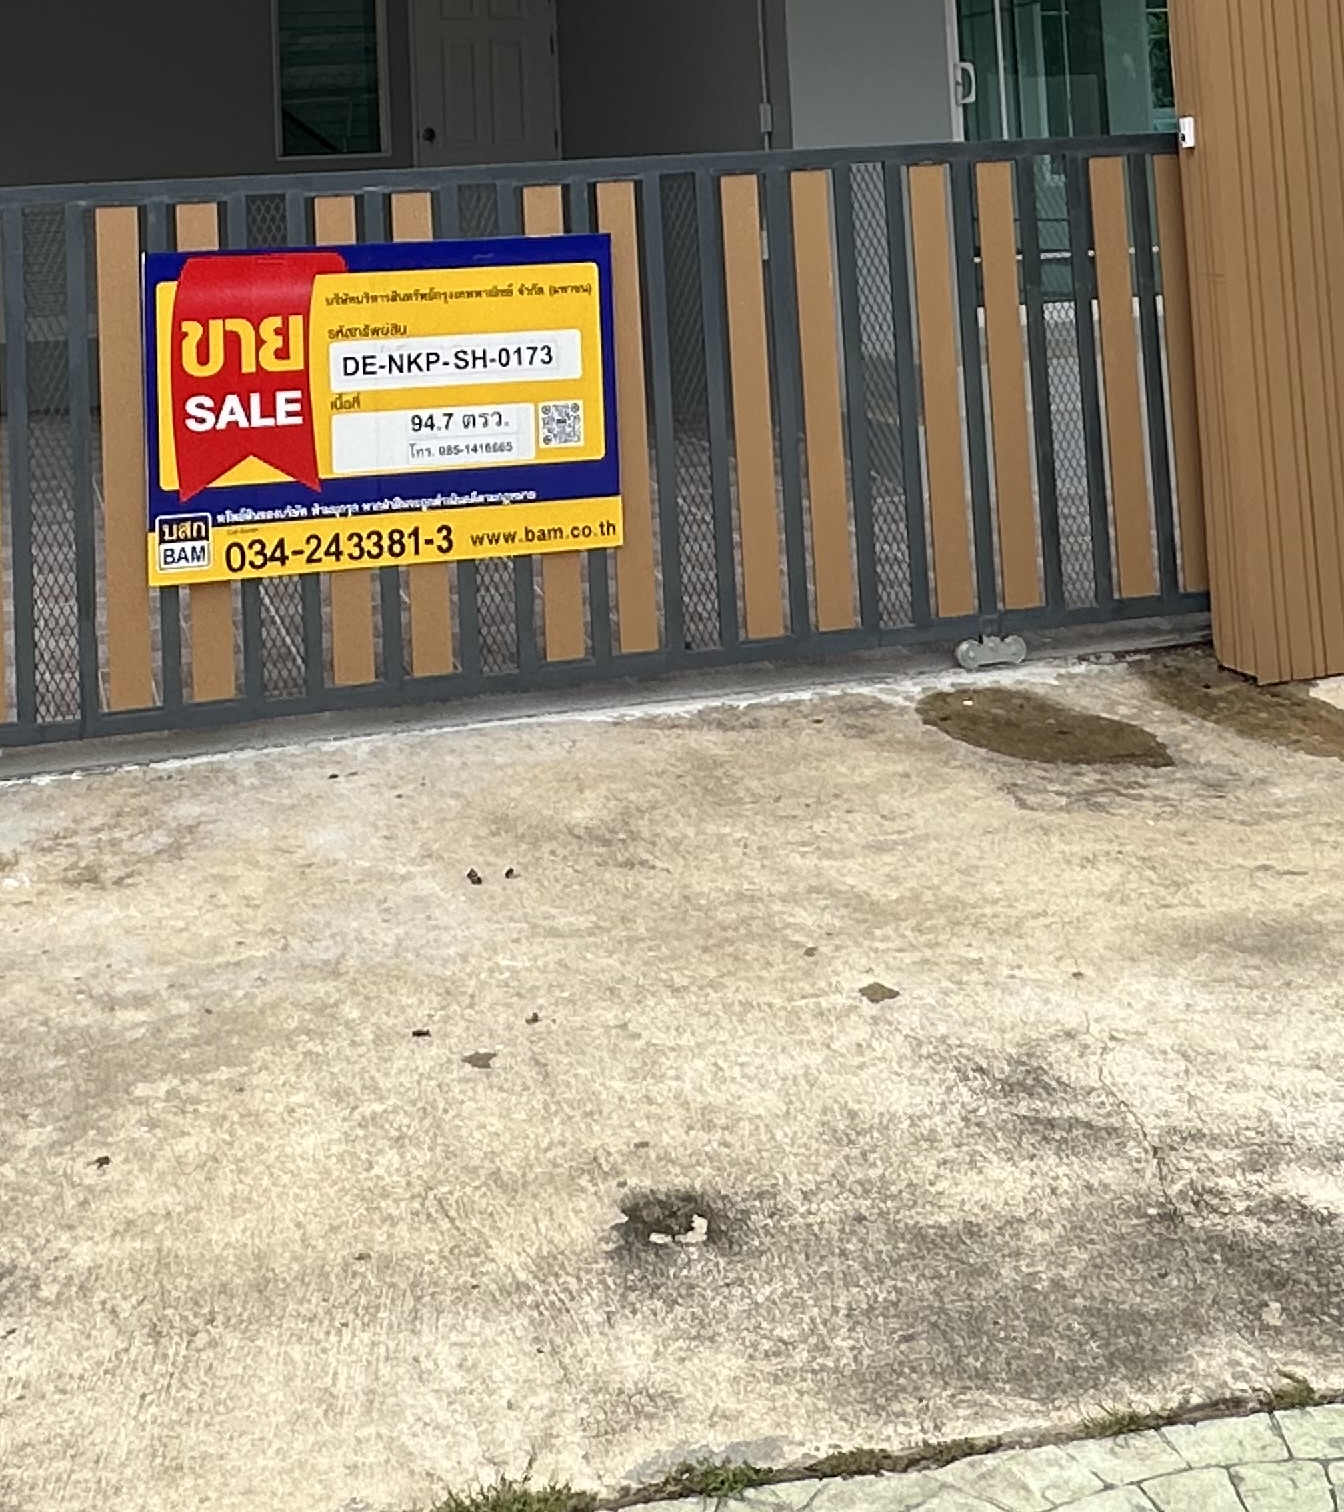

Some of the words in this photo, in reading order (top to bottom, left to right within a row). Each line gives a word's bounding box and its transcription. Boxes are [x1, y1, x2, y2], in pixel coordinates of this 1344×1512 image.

[181, 314, 304, 377] ขาย
[342, 344, 554, 376] DE-NKP-SH-0173
[184, 390, 303, 432] SALE
[410, 412, 454, 432] 94.7
[409, 442, 435, 458] โทร.
[162, 520, 206, 541] บสก
[163, 545, 206, 566] BAM
[224, 524, 454, 573] 034-243381-3
[470, 520, 617, 546] www.bam.co.th
